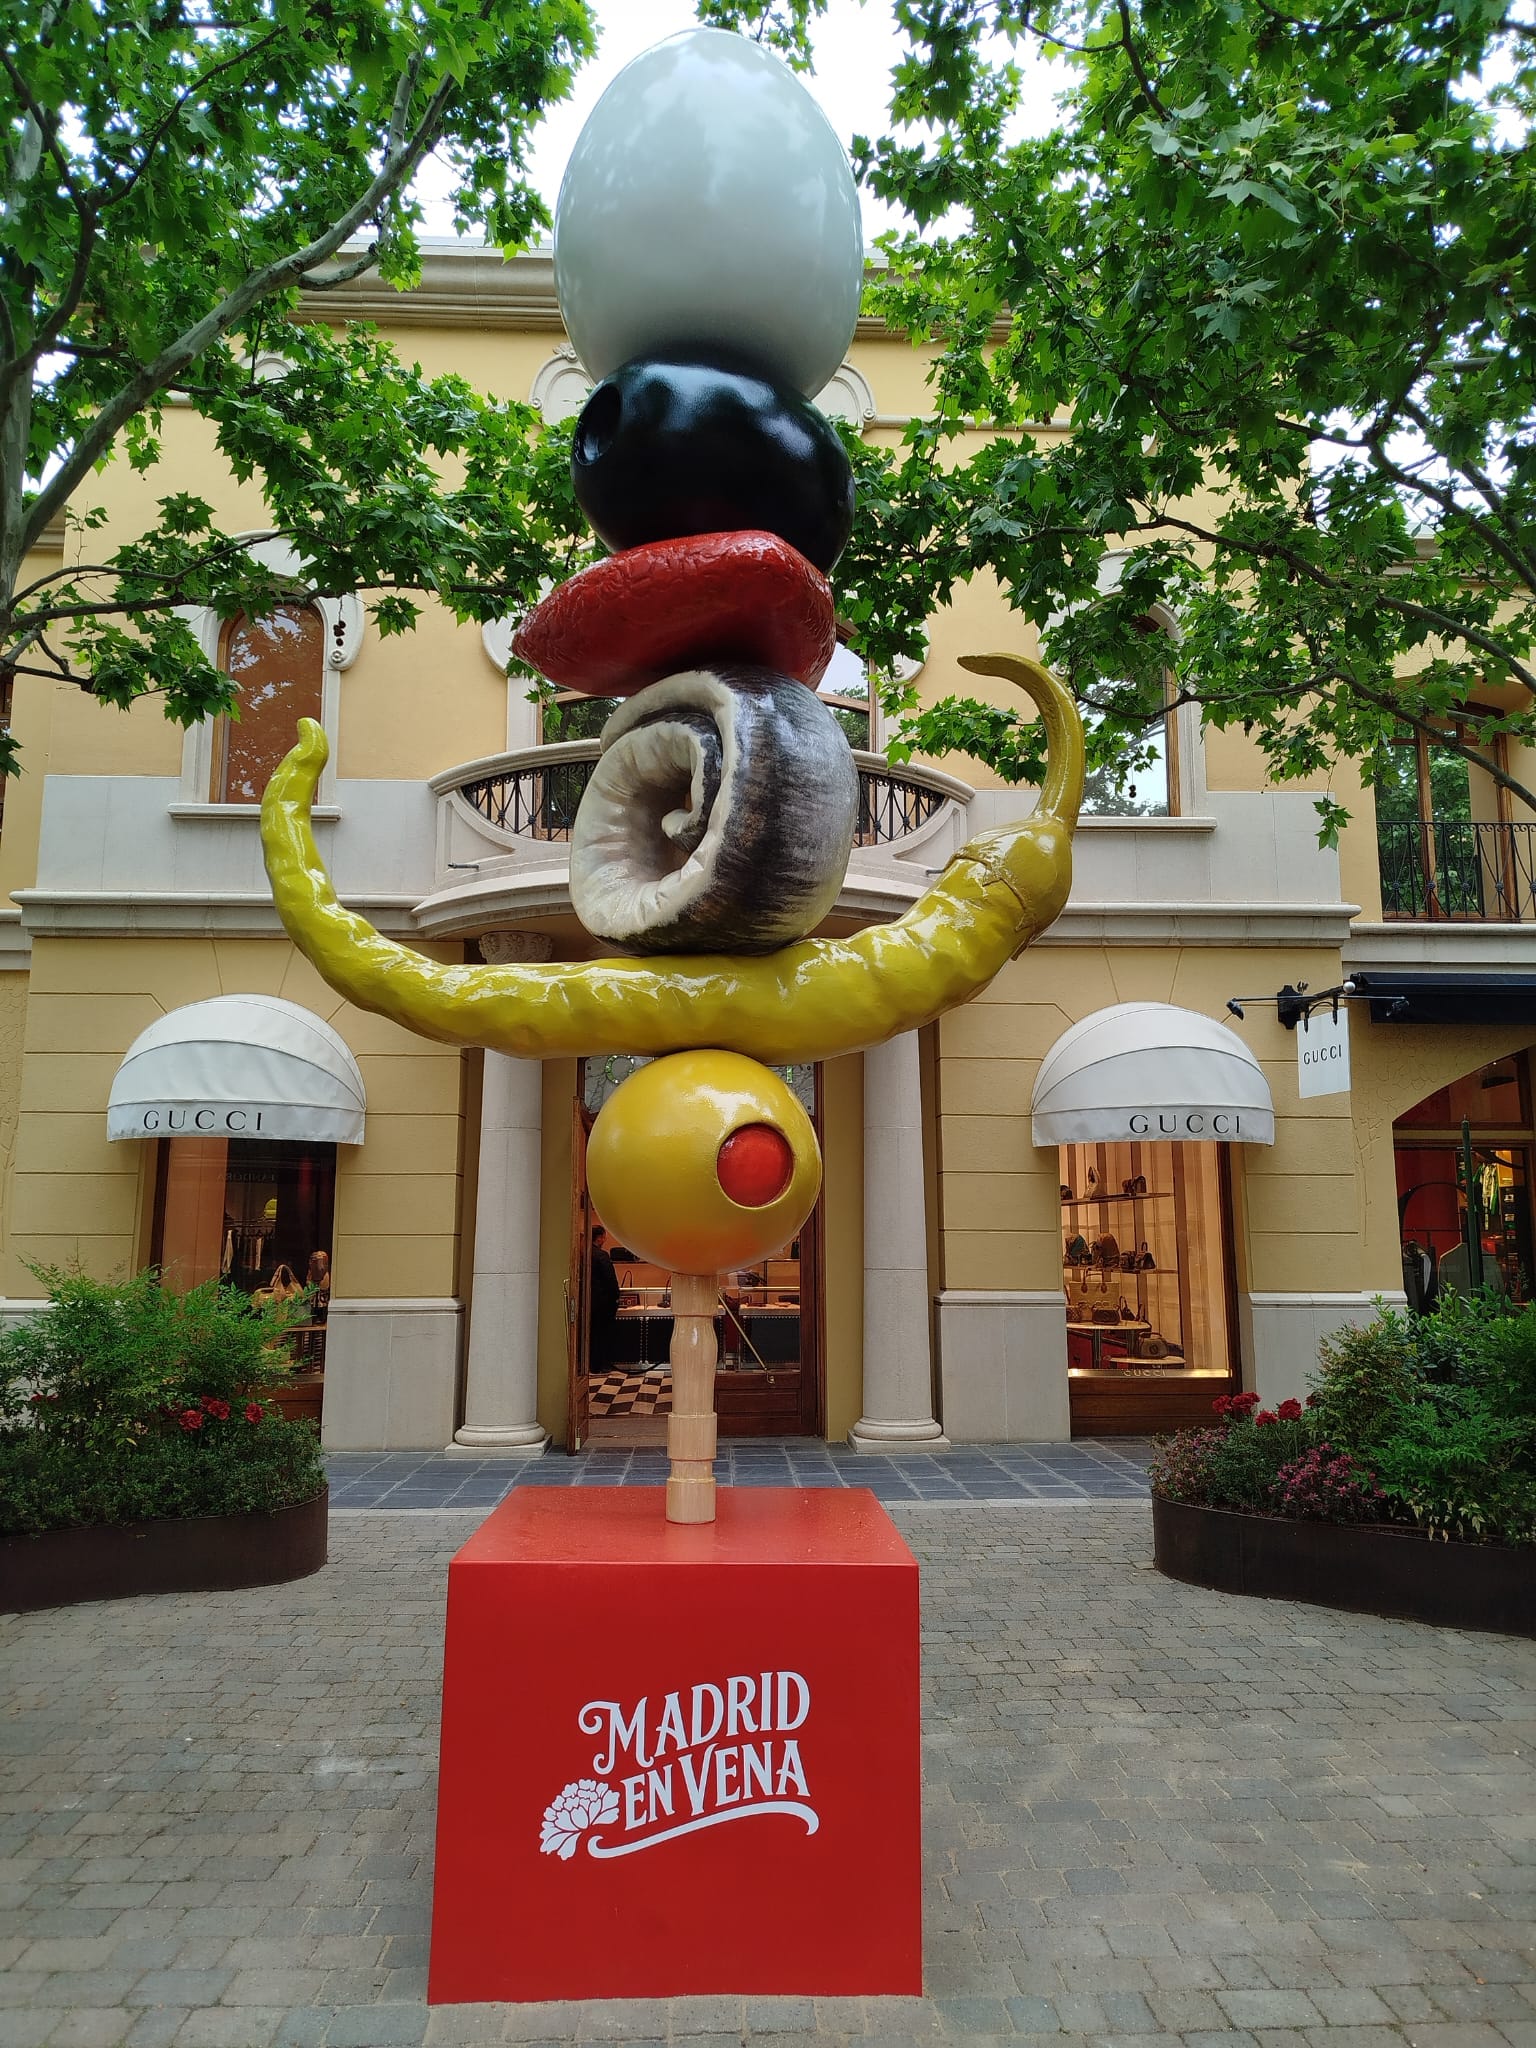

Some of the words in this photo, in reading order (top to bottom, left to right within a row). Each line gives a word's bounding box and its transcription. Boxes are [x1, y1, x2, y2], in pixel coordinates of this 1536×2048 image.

[1303, 1044, 1342, 1065] GUCCI
[143, 1109, 262, 1131] GUCCI
[1129, 1113, 1240, 1134] GUCCI
[578, 1671, 811, 1775] MADRID
[620, 1764, 675, 1831] EN
[679, 1740, 811, 1816] VENA
